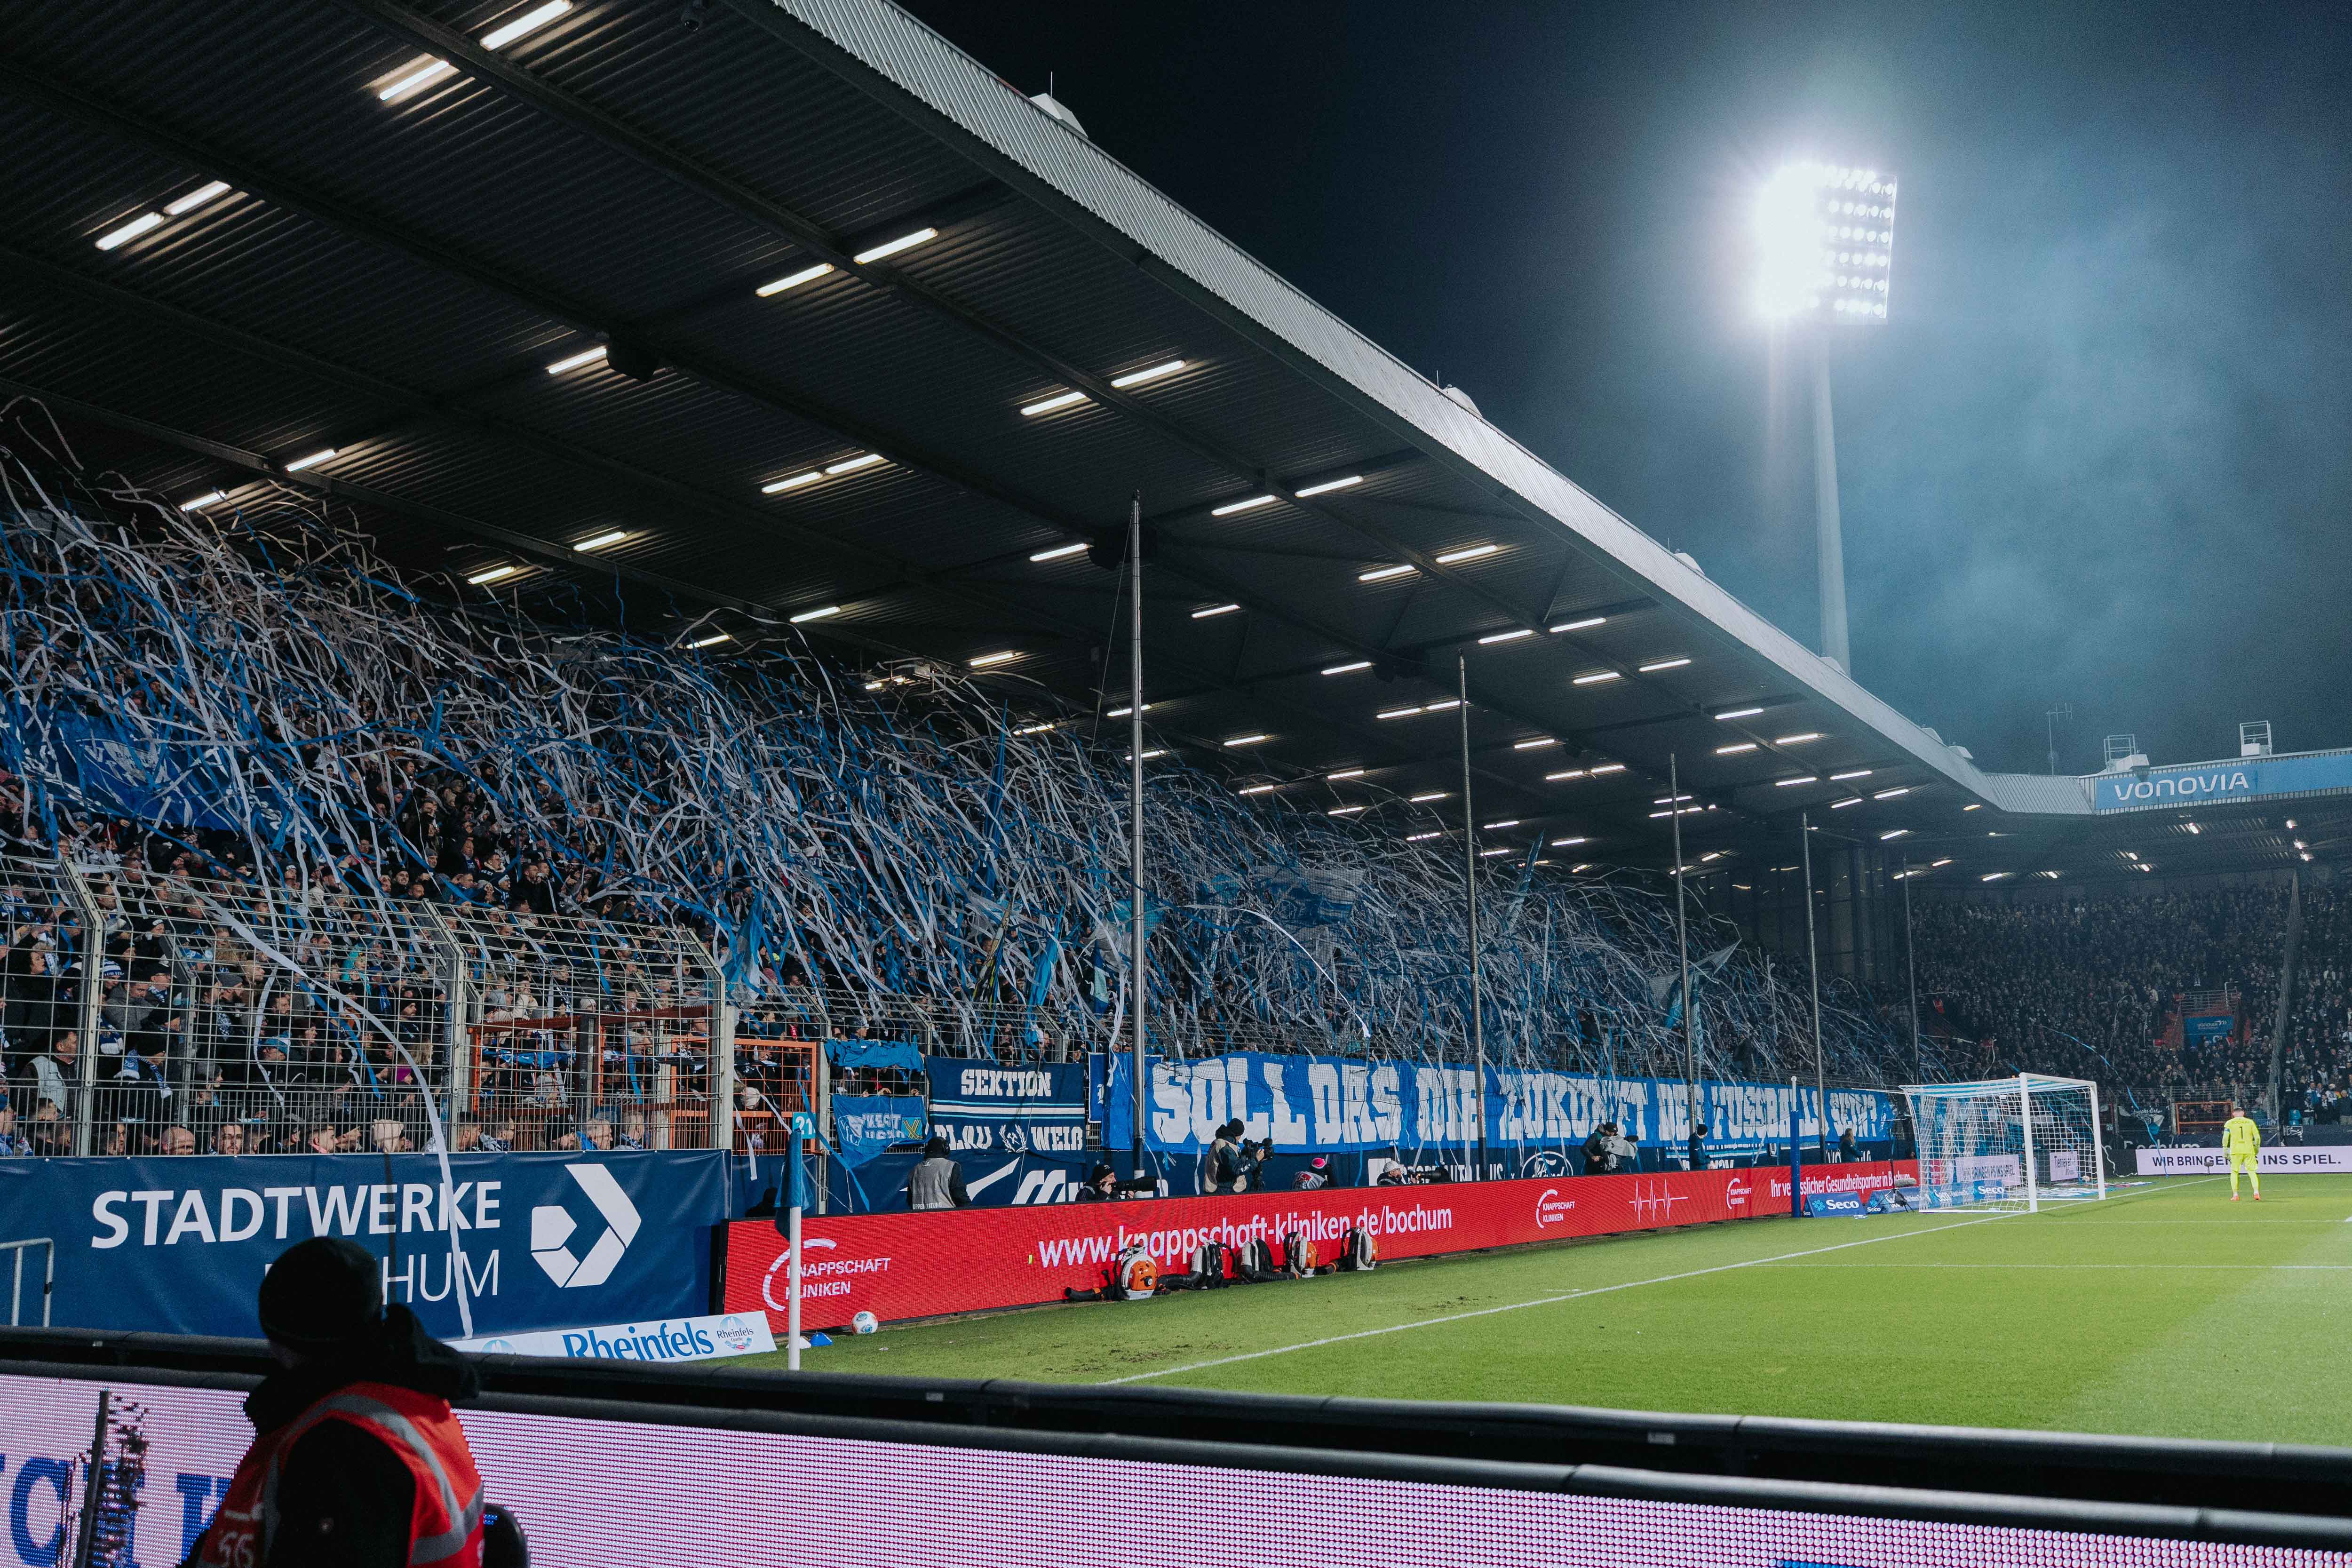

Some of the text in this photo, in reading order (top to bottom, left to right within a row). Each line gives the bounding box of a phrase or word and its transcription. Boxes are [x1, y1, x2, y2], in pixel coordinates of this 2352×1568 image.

[961, 1069, 1051, 1097] SEKTION
[1152, 1058, 1307, 1145] SOLL
[1308, 1064, 1402, 1145] DAS
[1498, 1073, 1649, 1141] ZUKUNFT
[1711, 1086, 1830, 1140] FUSSBALS
[934, 1125, 992, 1150] BLAU
[2239, 1126, 2243, 1139] 1
[2153, 1156, 2174, 1167] WIR
[2263, 1154, 2288, 1165] INS
[2292, 1154, 2341, 1165] SPIEL.
[1771, 1170, 1910, 1197] Ihr vesslicher Gesundheitspartner in Bchum
[1542, 1201, 1575, 1211] KNAPPSCHAFT
[1826, 1200, 1859, 1210] Seco
[91, 1181, 501, 1249] STADTWERKE
[1543, 1213, 1564, 1222] KLINIKEN
[1039, 1204, 1452, 1268] www.knappschaft-klinikende/bochum
[785, 1281, 850, 1300] INIKEN
[562, 1322, 715, 1361] Rheinfels
[716, 1328, 754, 1339] Rheinfels
